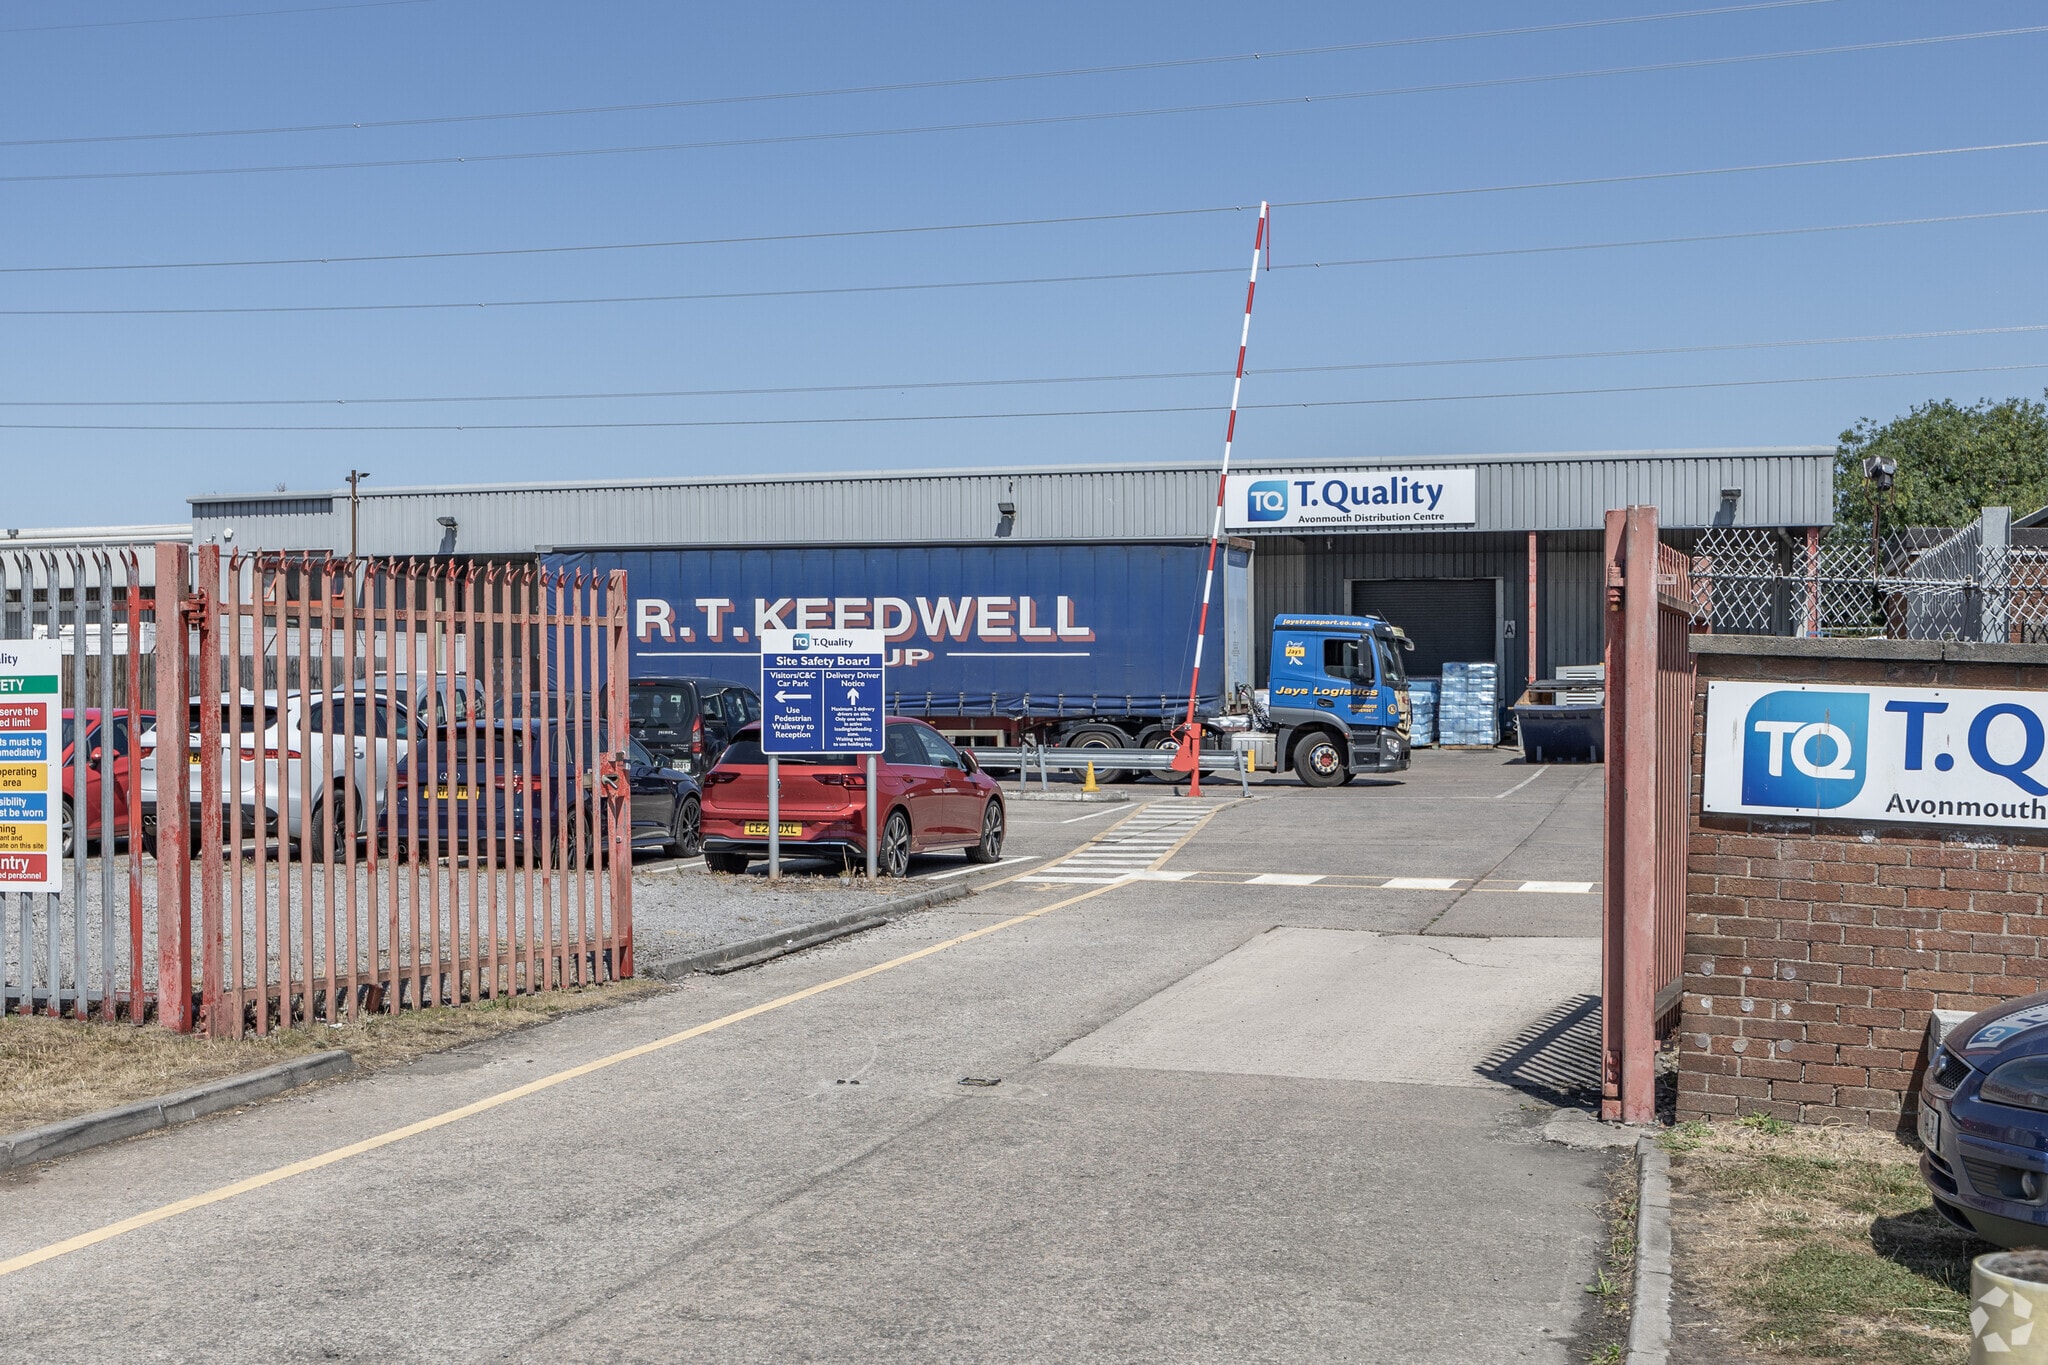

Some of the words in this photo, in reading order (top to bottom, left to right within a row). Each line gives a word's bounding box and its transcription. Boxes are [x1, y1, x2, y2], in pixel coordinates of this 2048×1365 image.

[1294, 476, 1443, 513] T.Quality
[1250, 491, 1285, 511] TQ
[1298, 513, 1352, 523] Avonmouth
[1354, 513, 1411, 522] Distribution
[1413, 512, 1445, 521] Centre
[755, 596, 1096, 642] KEEDWELL
[1505, 624, 1514, 635] A
[813, 637, 854, 648] T.Quality
[776, 656, 797, 666] Site
[800, 656, 834, 668] Safety
[837, 656, 870, 666] Board
[826, 672, 855, 680] Delivery
[1275, 686, 1309, 696] Jays
[1313, 686, 1379, 697] Logistics
[25, 706, 39, 716] the
[12, 717, 31, 727] limit
[772, 723, 805, 731] Walkway
[775, 731, 811, 740] Reception
[9, 738, 30, 746] must
[31, 737, 42, 746] be
[0, 748, 42, 758] mediately
[1754, 720, 1855, 780] TQ
[3, 779, 22, 787] area
[1885, 793, 2047, 820] Avonmouth
[9, 808, 20, 817] be
[22, 809, 44, 817] worn
[8, 872, 42, 880] personnel
